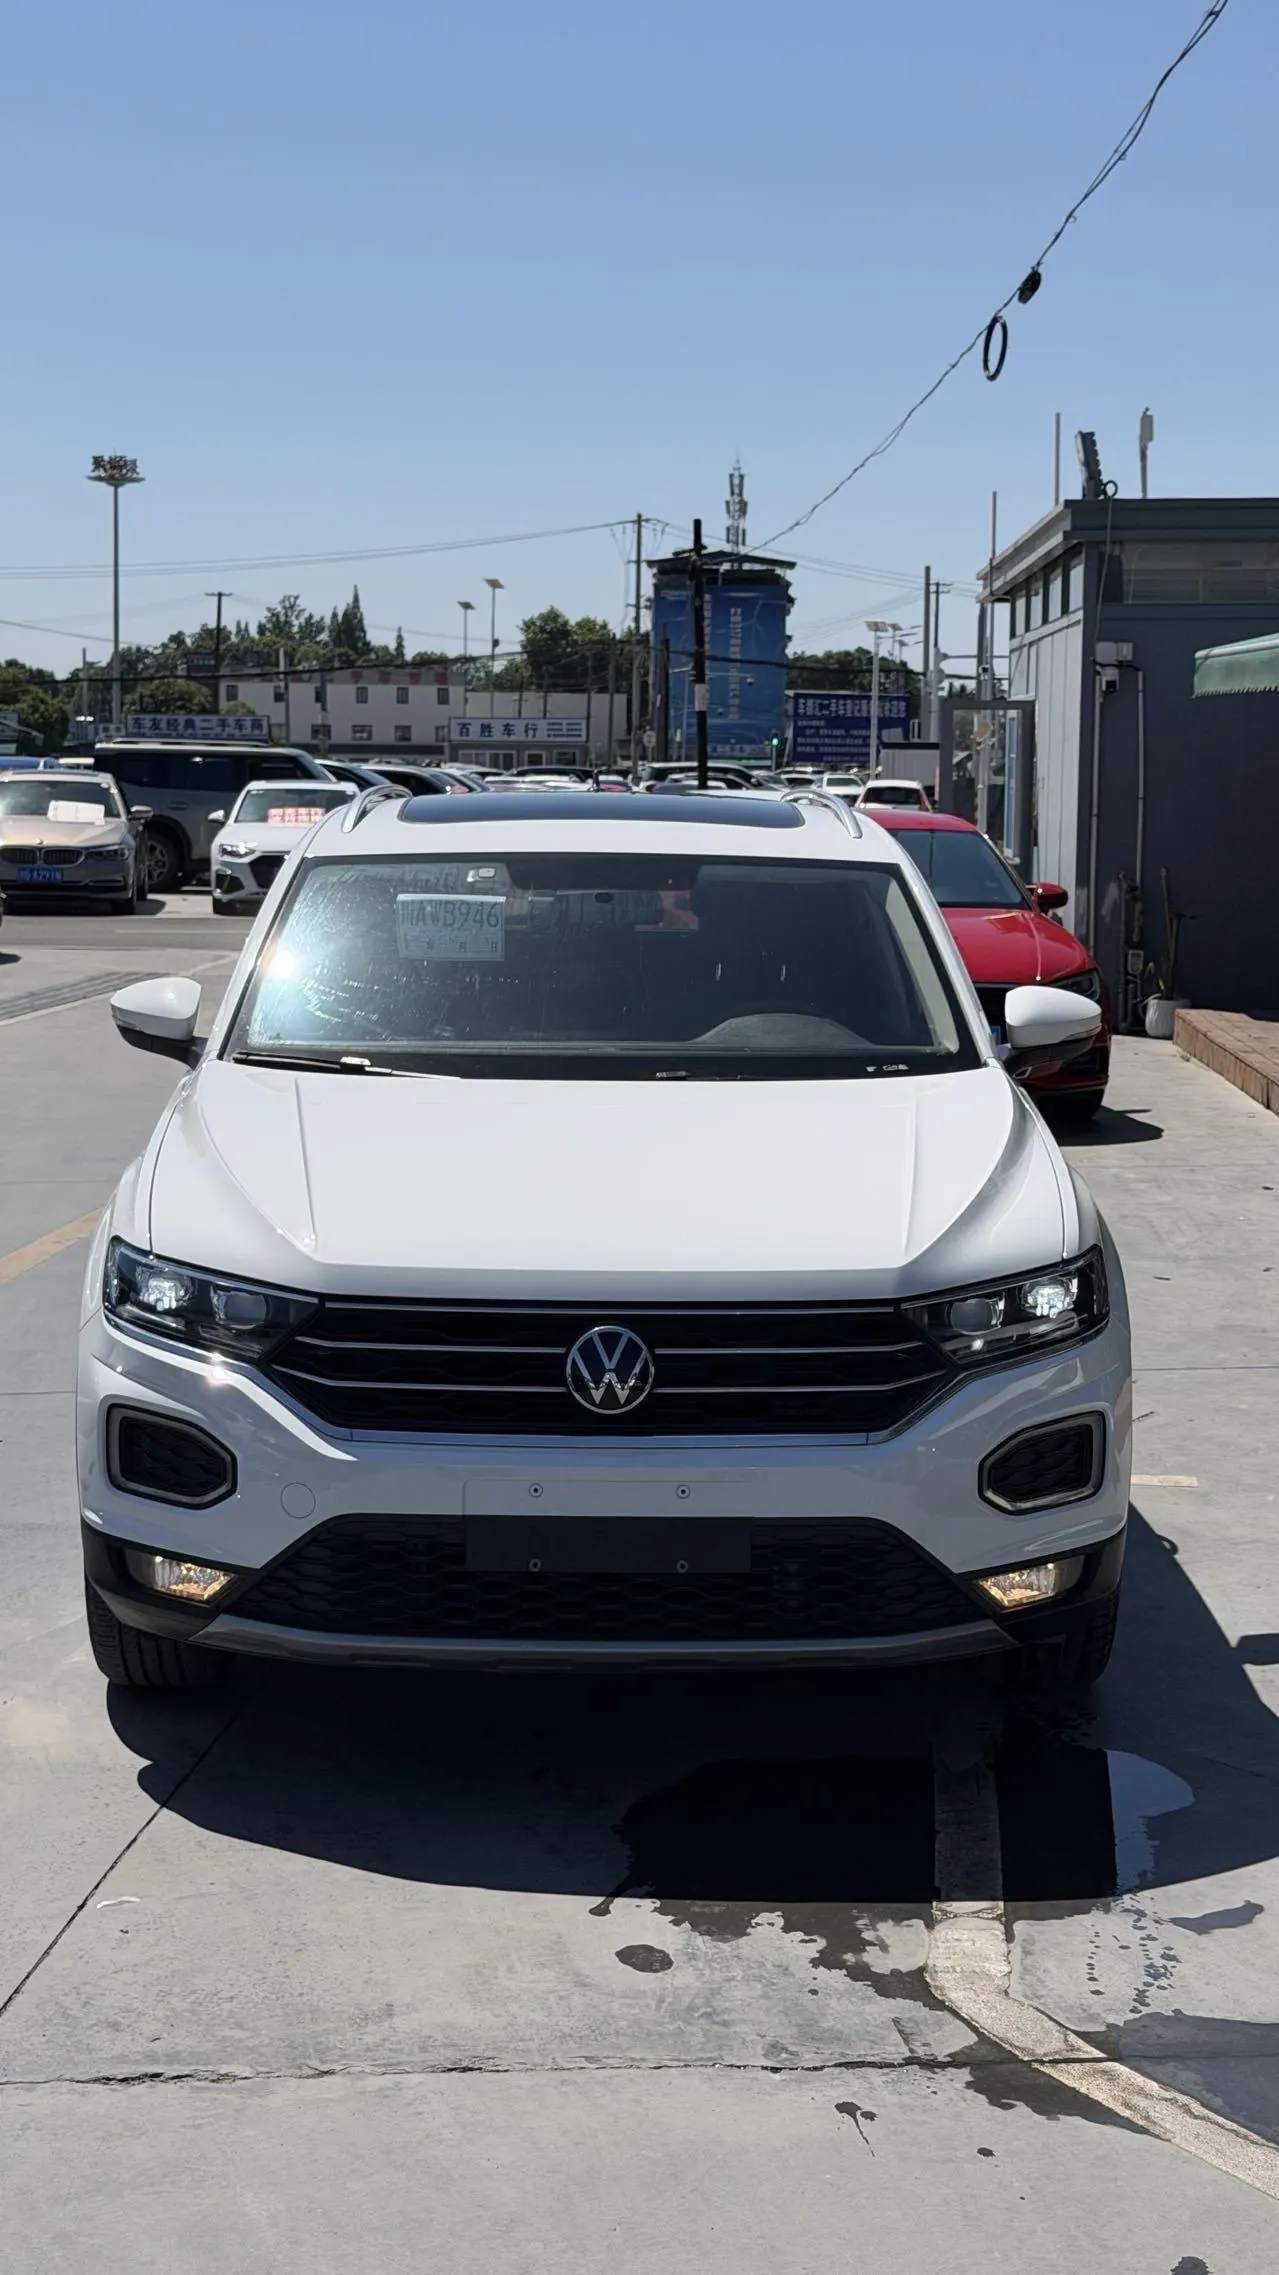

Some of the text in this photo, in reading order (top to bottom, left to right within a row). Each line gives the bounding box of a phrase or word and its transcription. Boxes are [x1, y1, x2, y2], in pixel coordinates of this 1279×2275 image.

[457, 722, 539, 739] 百胜车行
[570, 1329, 650, 1409] VW
